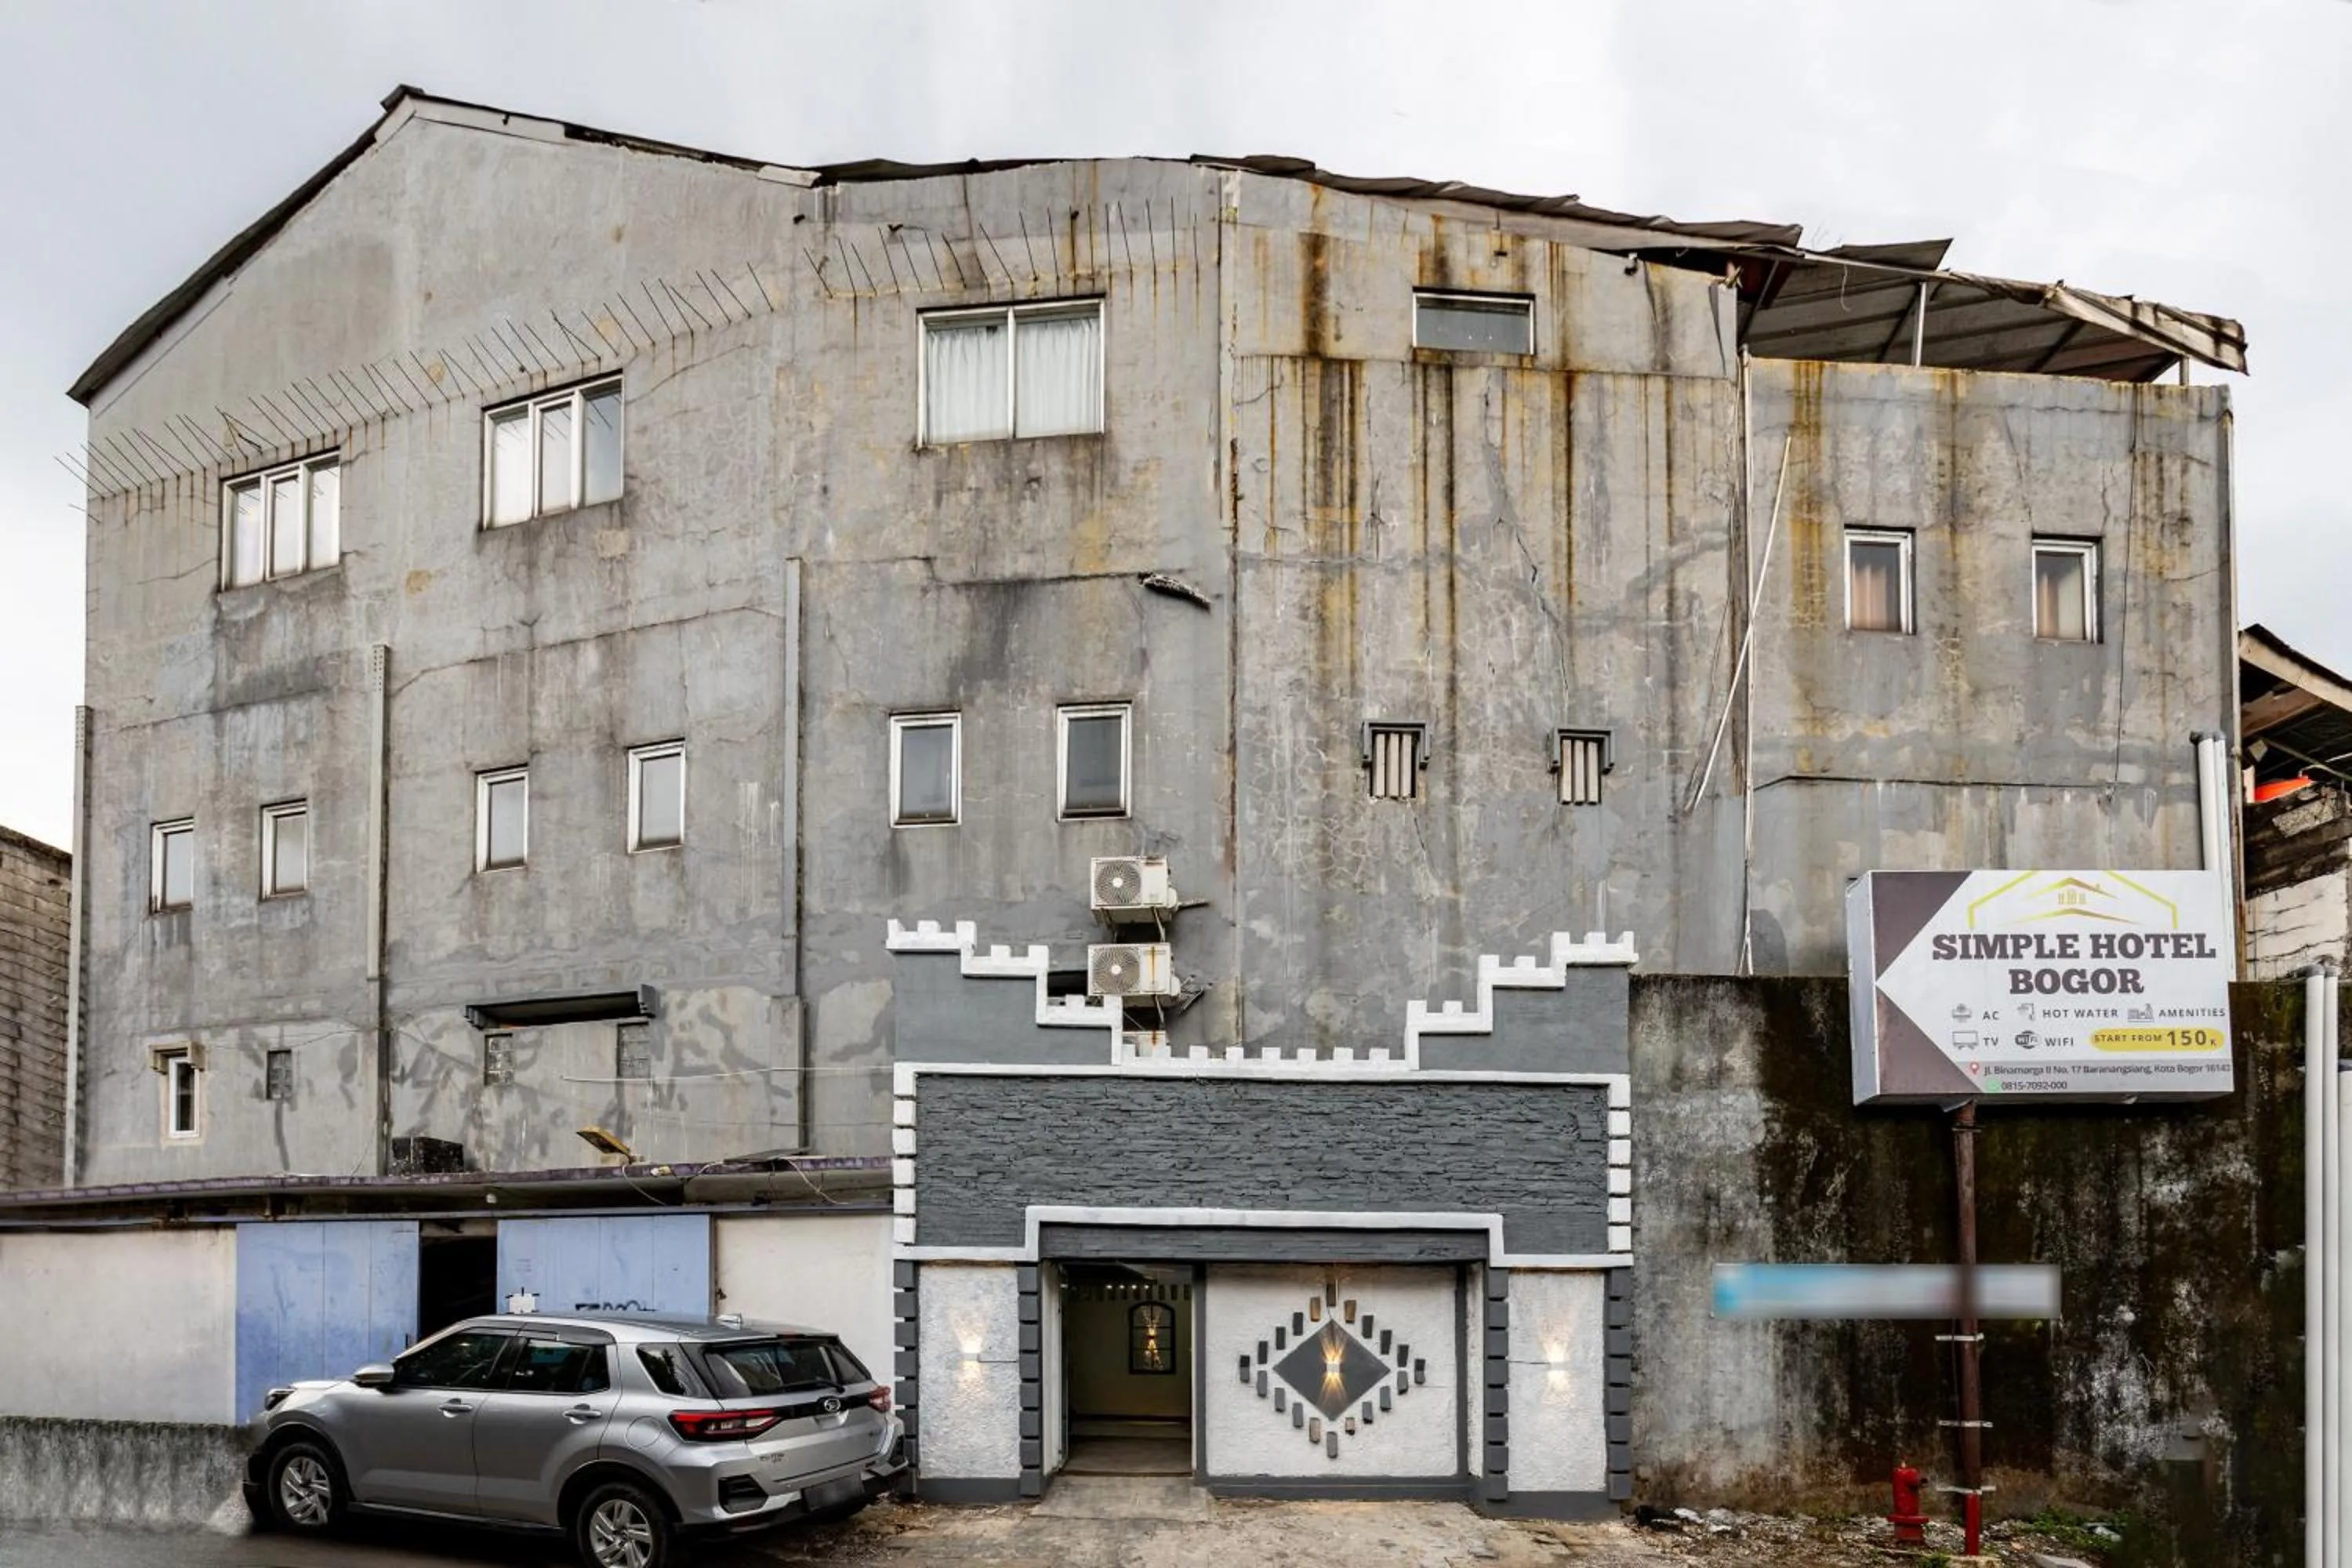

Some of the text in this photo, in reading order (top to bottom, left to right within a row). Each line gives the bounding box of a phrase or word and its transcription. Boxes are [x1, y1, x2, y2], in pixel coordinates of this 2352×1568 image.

[1932, 933, 2217, 960] SIMPLE HOTEL
[2009, 967, 2145, 995] BOGOR
[1982, 1011, 2000, 1021] AC
[2042, 1008, 2119, 1018] HOT WATER
[2158, 1007, 2227, 1018] AMENITIES
[1983, 1037, 1999, 1047] TV
[2044, 1036, 2074, 1047] WIFI
[2093, 1033, 2127, 1043] START
[2131, 1033, 2162, 1043] FROM
[2177, 1064, 2203, 1075] Bogor
